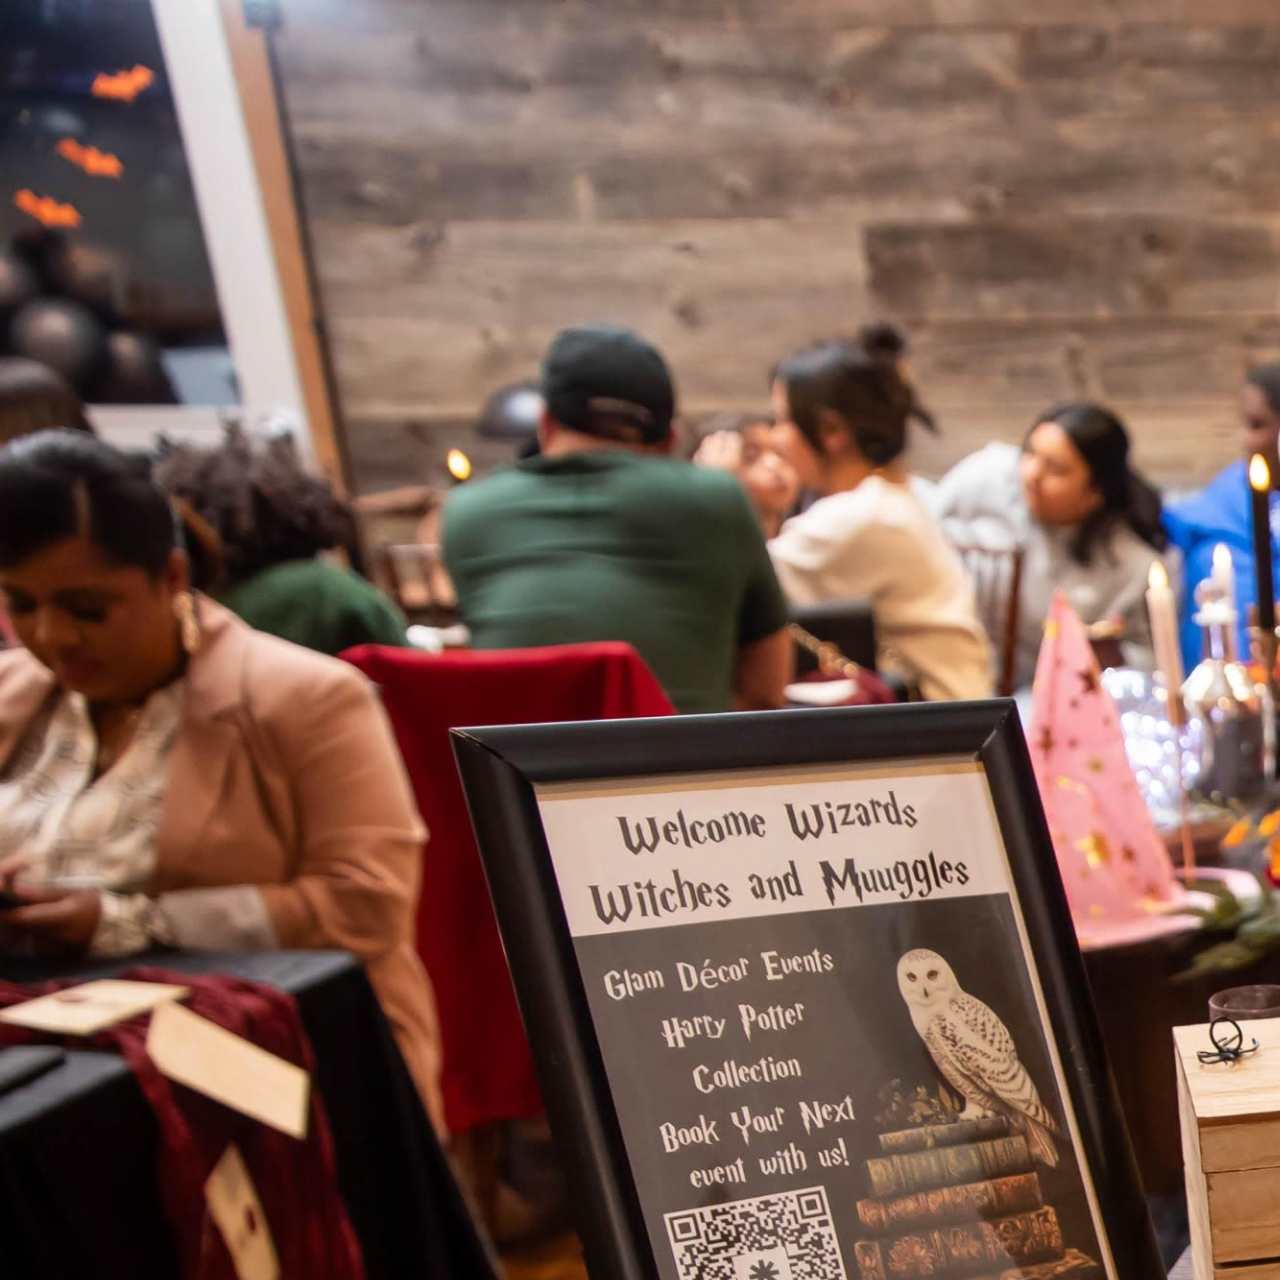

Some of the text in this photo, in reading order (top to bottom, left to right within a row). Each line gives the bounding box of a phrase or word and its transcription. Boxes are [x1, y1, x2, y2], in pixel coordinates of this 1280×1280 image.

[616, 790, 919, 856] Welcome Wizards
[588, 851, 970, 926] Witches and Muuggles
[603, 948, 834, 1001] Glam Décor Events
[661, 1002, 805, 1048] Harry Potter
[692, 1055, 803, 1094] Collection
[659, 1095, 856, 1153] Book Your Next
[689, 1137, 850, 1189] event with us!
